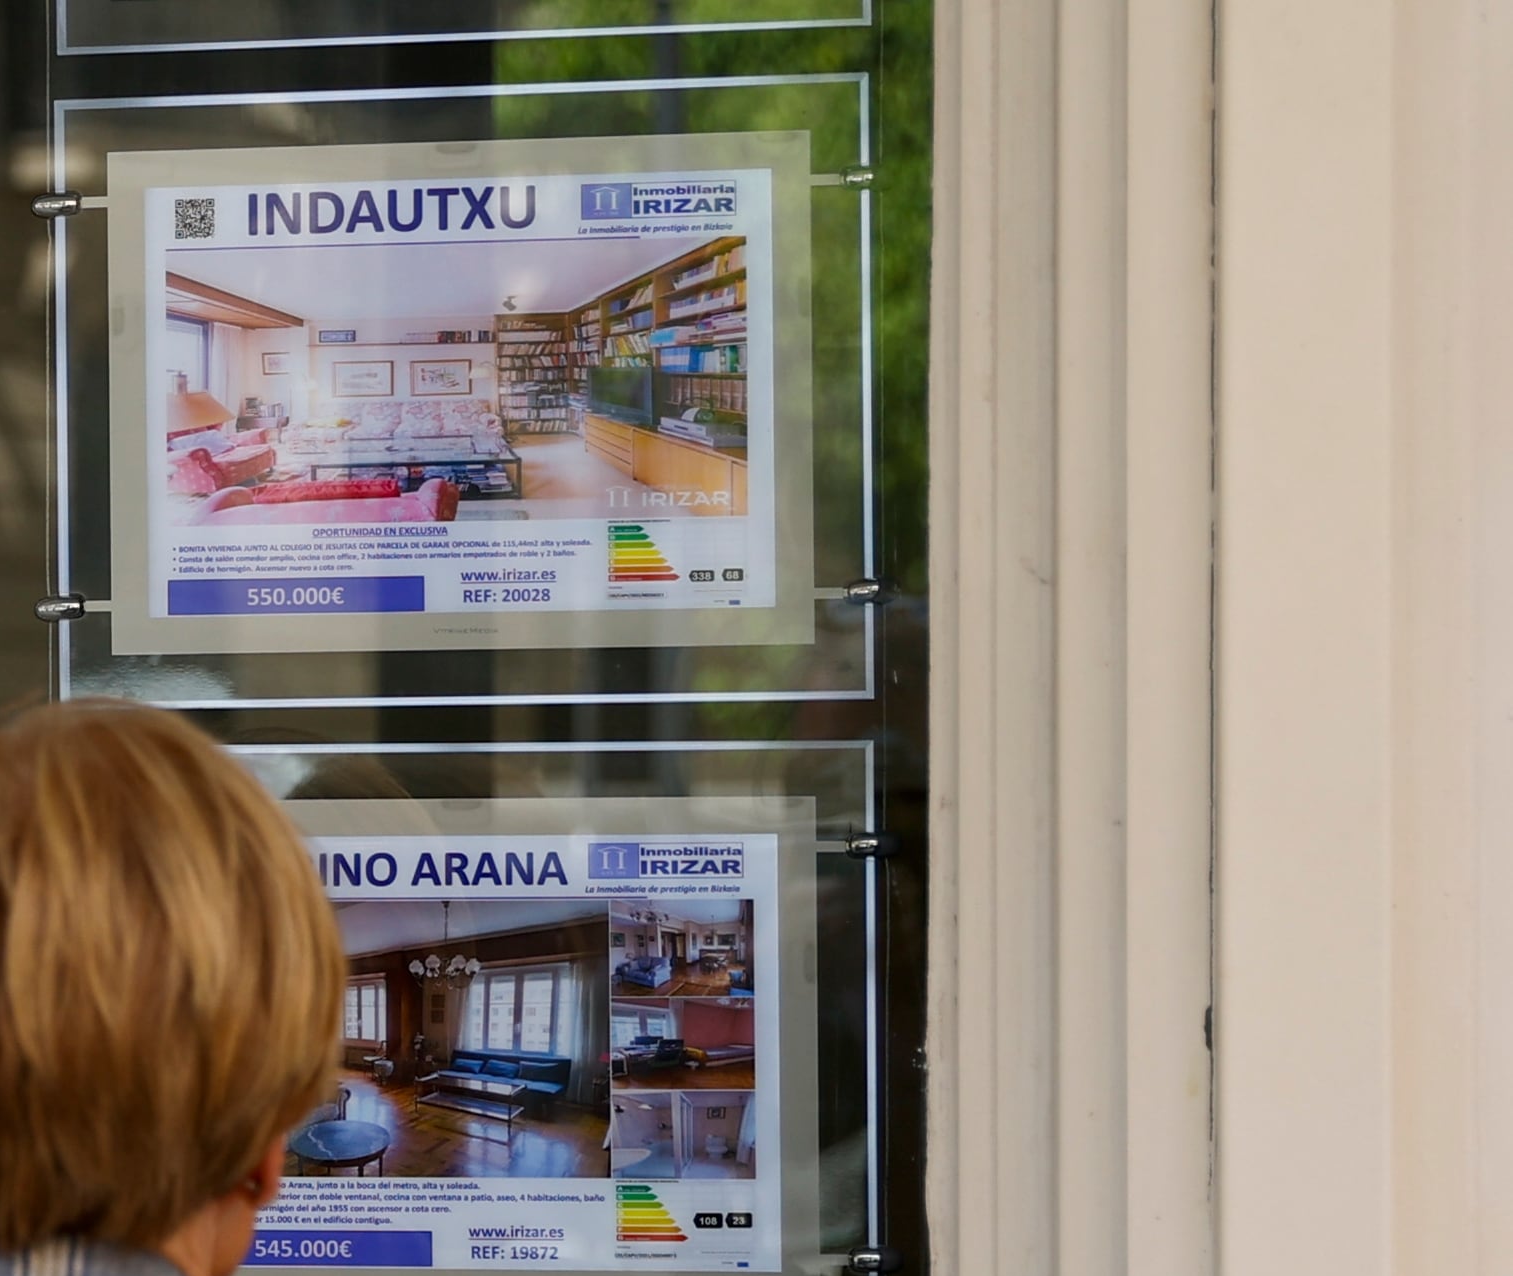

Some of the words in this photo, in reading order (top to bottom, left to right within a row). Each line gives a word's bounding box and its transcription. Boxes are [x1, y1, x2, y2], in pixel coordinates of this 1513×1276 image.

[633, 184, 735, 196] Inmobiliaria
[248, 186, 536, 235] INDAUTXU
[633, 198, 733, 214] IRIZAR
[641, 490, 730, 507] IRIZAR
[312, 527, 382, 537] OPORTUNIDAD
[384, 527, 397, 536] EN
[399, 526, 448, 536] EXCLUSIVA
[461, 568, 556, 582] www.irizar.es
[692, 571, 711, 580] 338
[725, 571, 739, 580] 68
[247, 587, 344, 605] 550.000€
[463, 589, 497, 603] REF:
[502, 588, 550, 602] 20028
[640, 846, 742, 857] Inmobiliaria
[319, 852, 397, 887] INO
[411, 851, 568, 887] ARANA
[639, 859, 741, 875] IRIZAR
[648, 885, 658, 893] de
[660, 885, 696, 894] prestigio
[711, 885, 740, 893] Bizkaia
[289, 1181, 314, 1190] Arana,
[316, 1181, 338, 1190] junto
[347, 1181, 355, 1189] la
[357, 1181, 376, 1189] boca
[378, 1181, 391, 1189] del
[393, 1182, 420, 1190] metro,
[422, 1182, 437, 1190] alta
[440, 1183, 445, 1191] y
[446, 1182, 480, 1190] soleada.
[732, 1216, 746, 1226] 23
[468, 1226, 564, 1239] www.irizar.es
[254, 1240, 352, 1258] 545.000€
[471, 1246, 504, 1259] REF:
[510, 1246, 559, 1259] 19872
